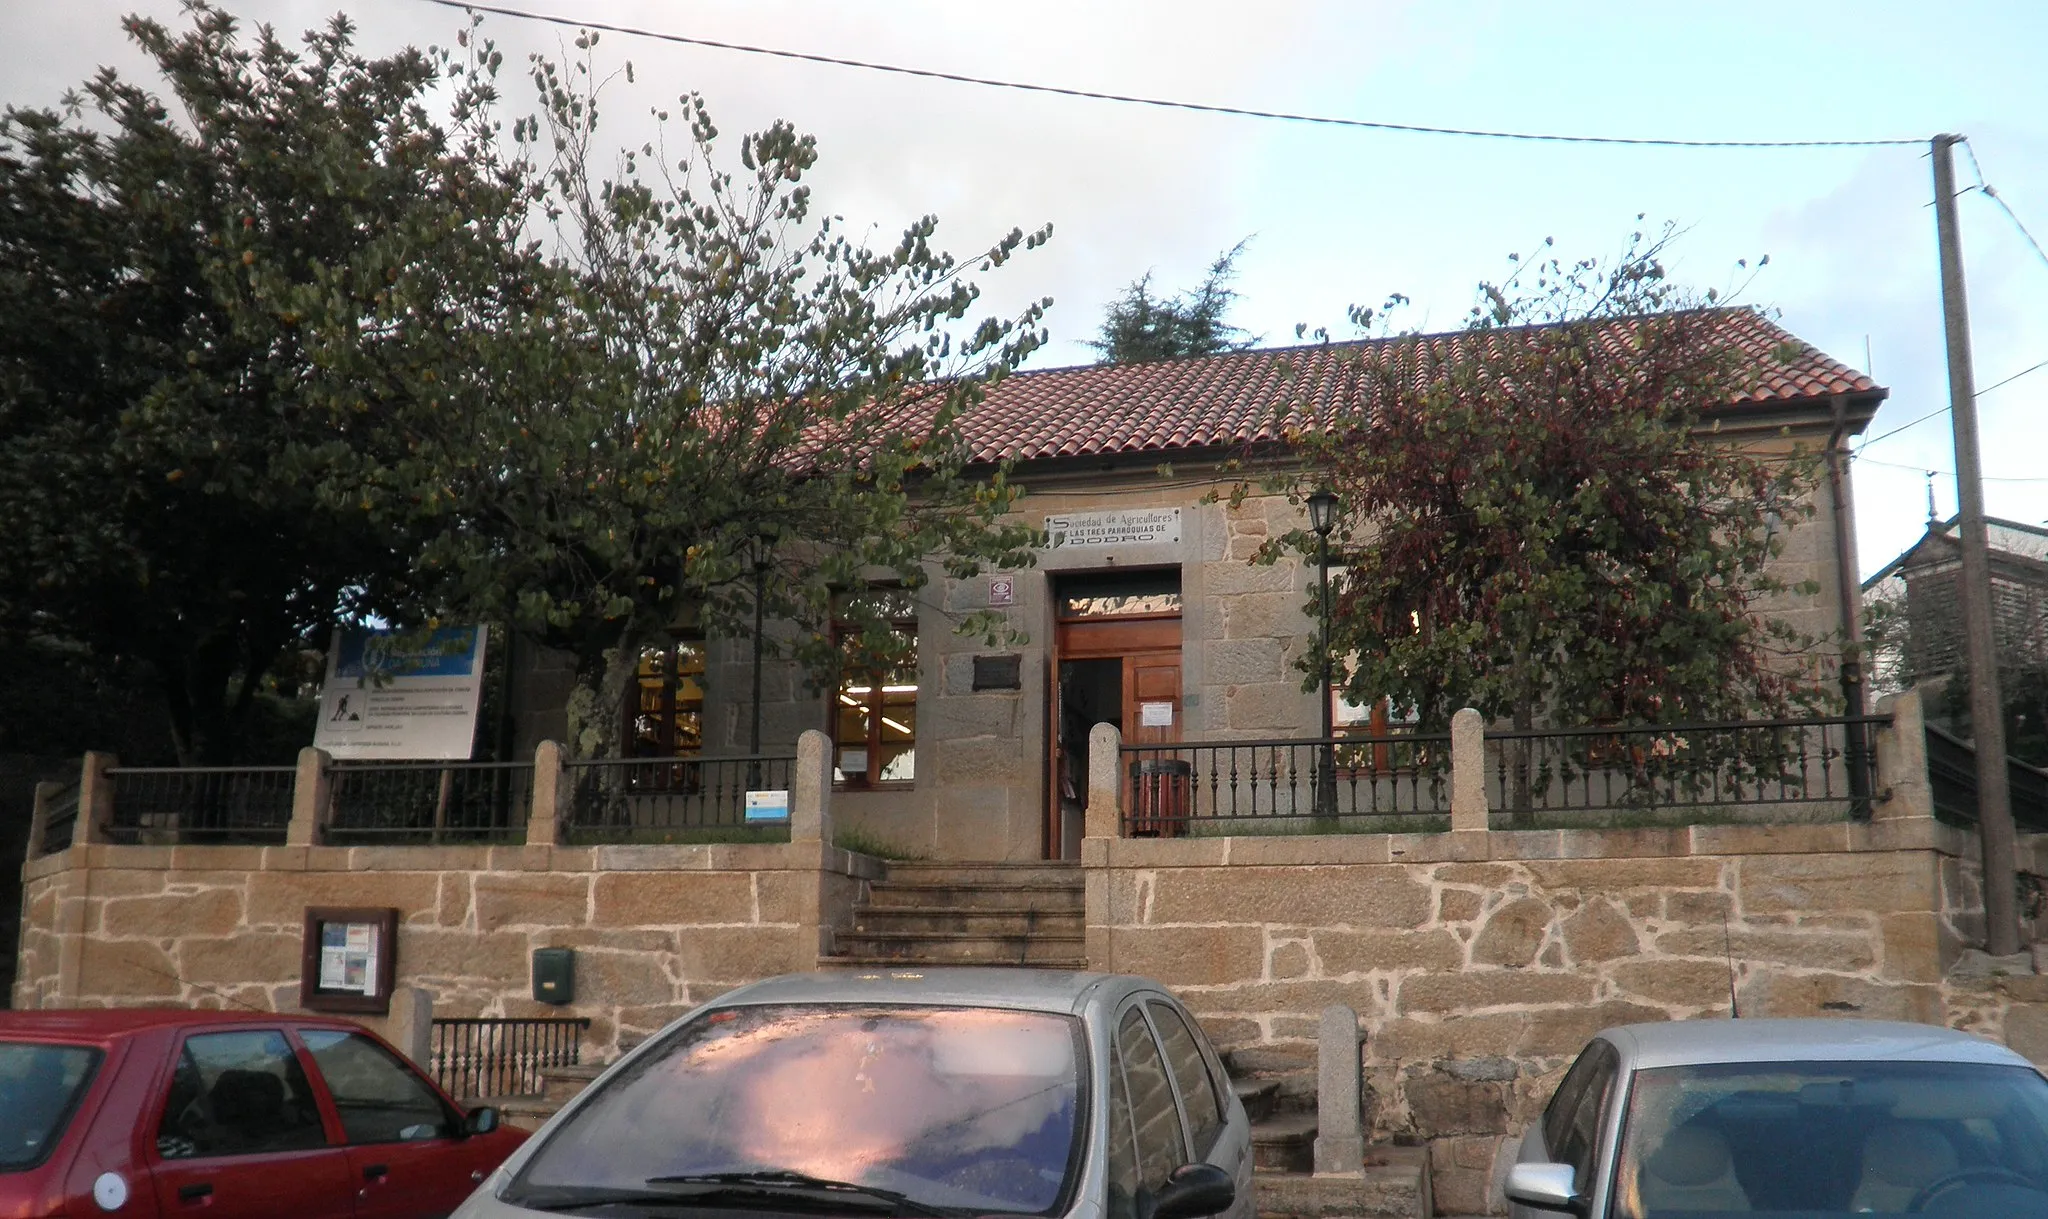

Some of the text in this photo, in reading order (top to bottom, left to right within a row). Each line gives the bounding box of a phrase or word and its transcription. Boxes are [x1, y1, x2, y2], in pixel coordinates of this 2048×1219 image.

[1053, 516, 1102, 528] Sociedad
[1106, 514, 1117, 524] de
[1070, 529, 1085, 537] LAS
[1087, 527, 1106, 535] TRES
[1107, 525, 1155, 535] PARROQUIAS
[1156, 524, 1166, 532] DE
[1070, 534, 1154, 545] DODRO
